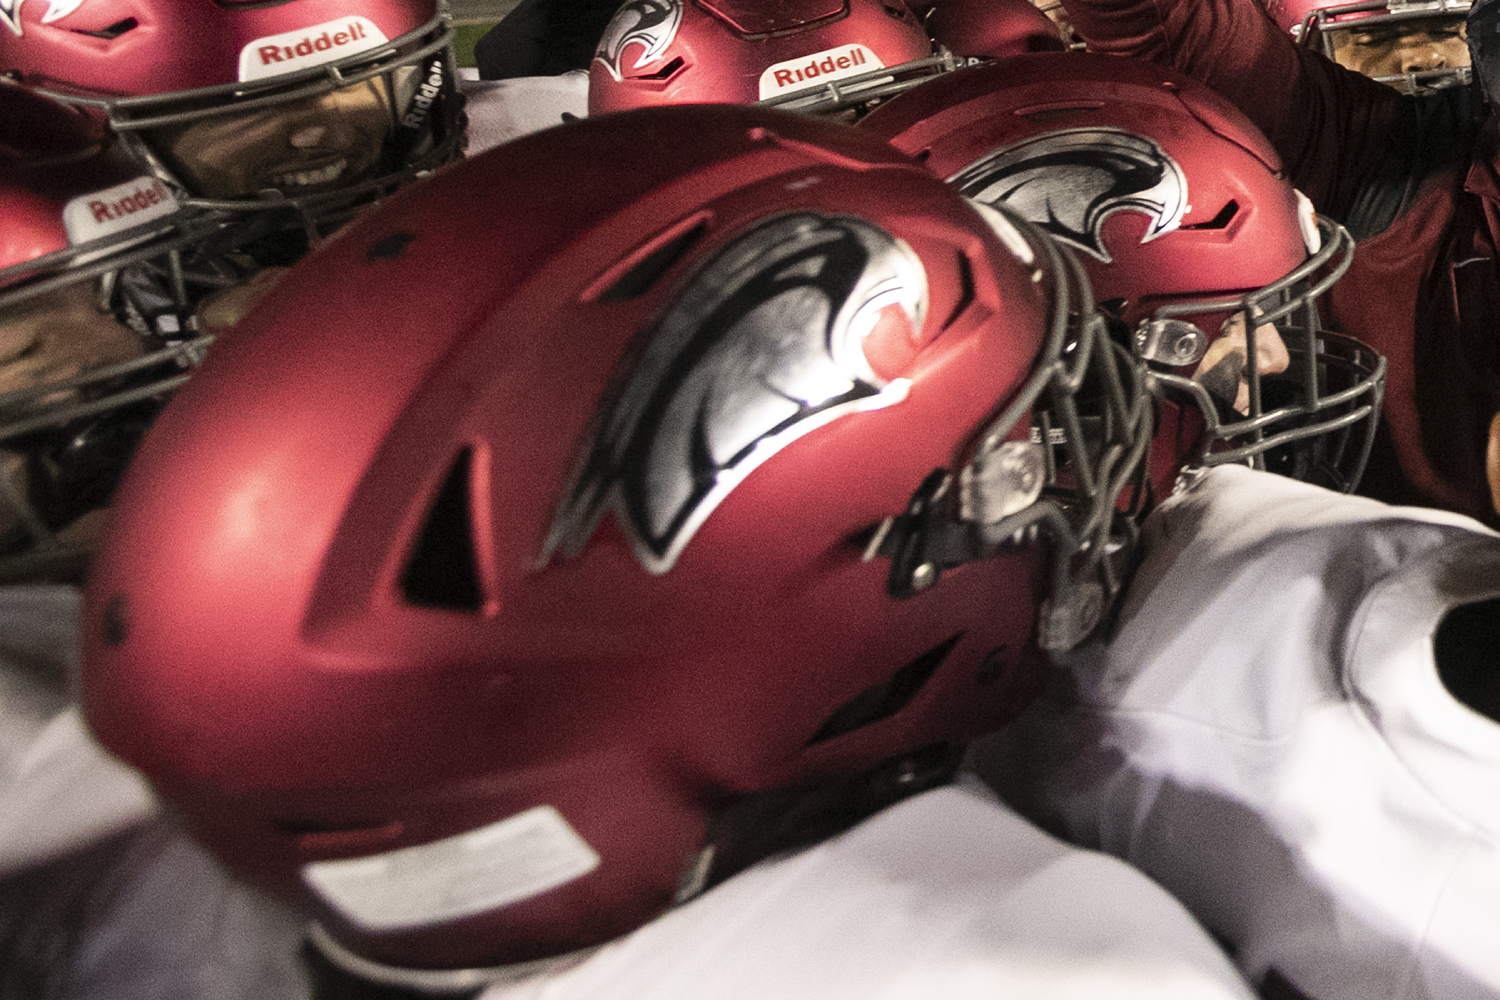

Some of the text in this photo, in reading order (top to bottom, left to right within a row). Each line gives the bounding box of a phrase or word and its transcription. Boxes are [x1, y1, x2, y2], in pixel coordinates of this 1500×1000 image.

[258, 21, 367, 65] Riddell
[773, 47, 867, 87] Riddell
[402, 60, 443, 129] Riddell
